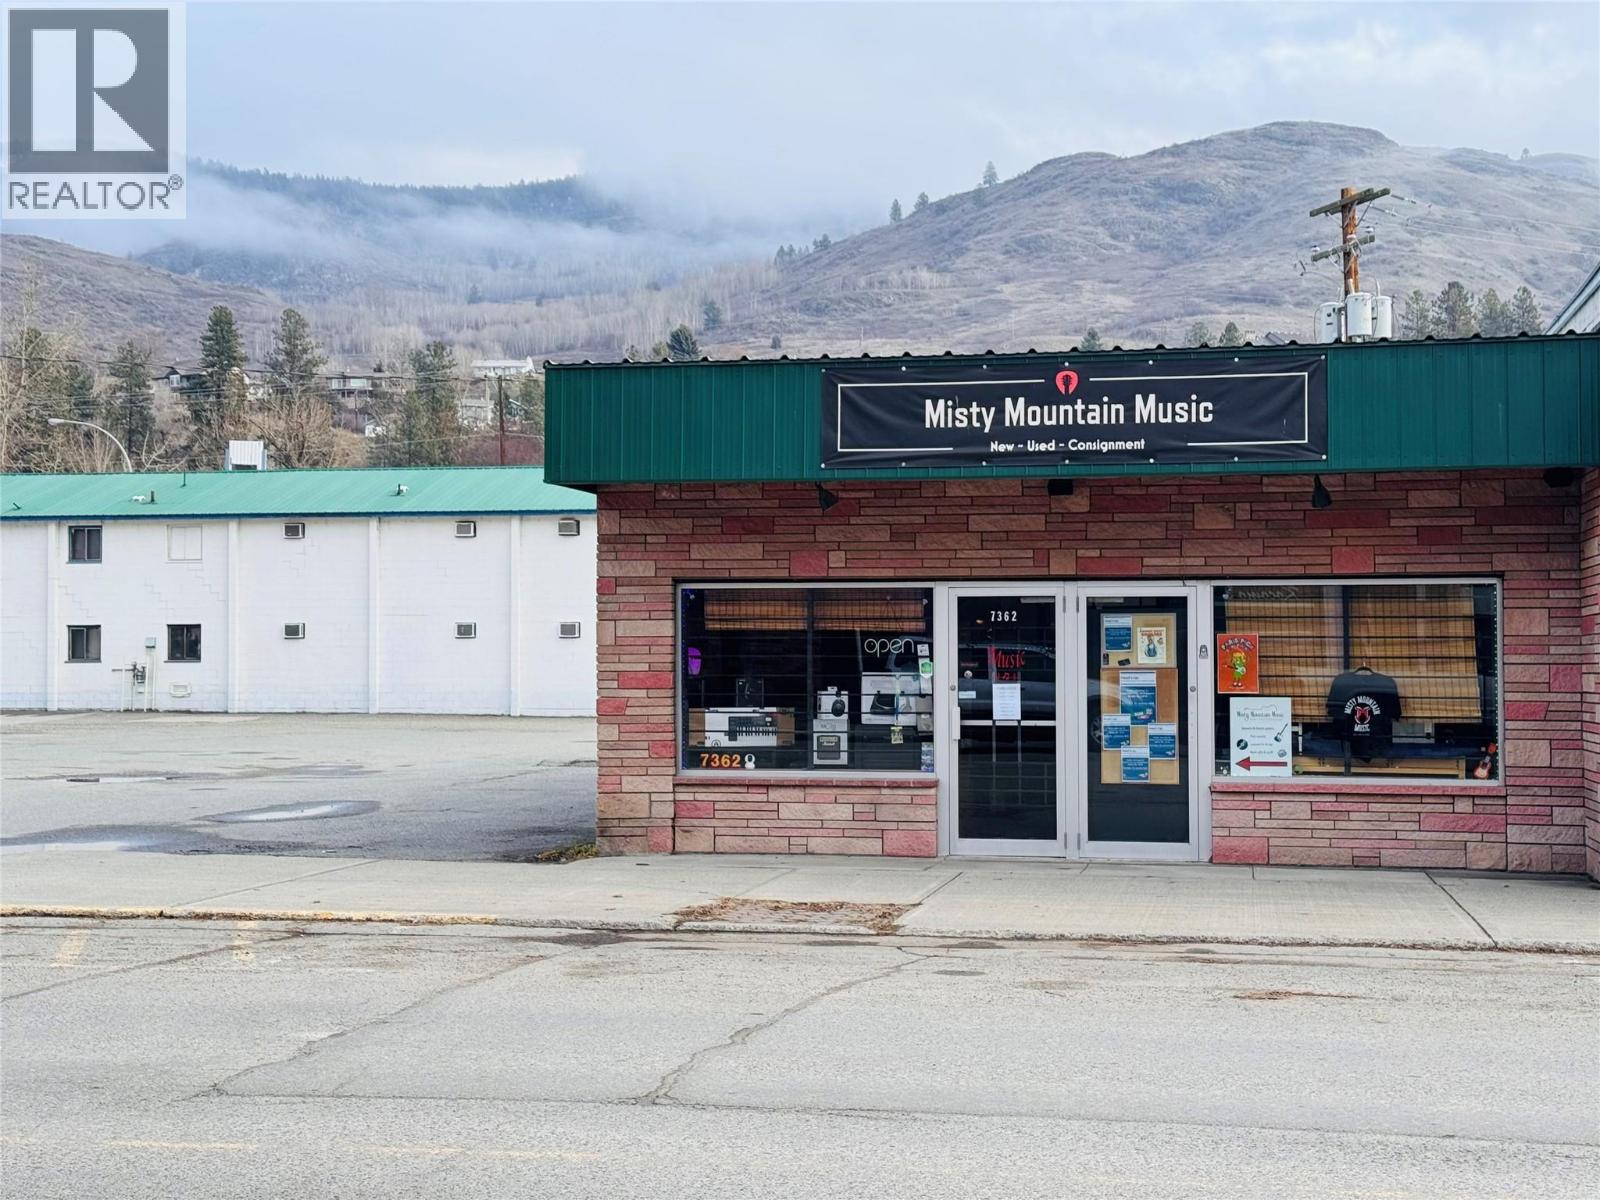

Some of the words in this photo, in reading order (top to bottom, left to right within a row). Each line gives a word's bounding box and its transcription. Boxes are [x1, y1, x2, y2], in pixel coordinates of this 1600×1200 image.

[925, 399, 996, 433] Misty
[1004, 396, 1125, 427] Mountain
[1135, 393, 1213, 424] Music
[990, 441, 1015, 452] New
[1027, 440, 1056, 452] Used
[1068, 438, 1146, 453] Consignment
[990, 610, 1017, 622] 7362
[864, 638, 914, 658] open
[700, 753, 741, 768] 7362
